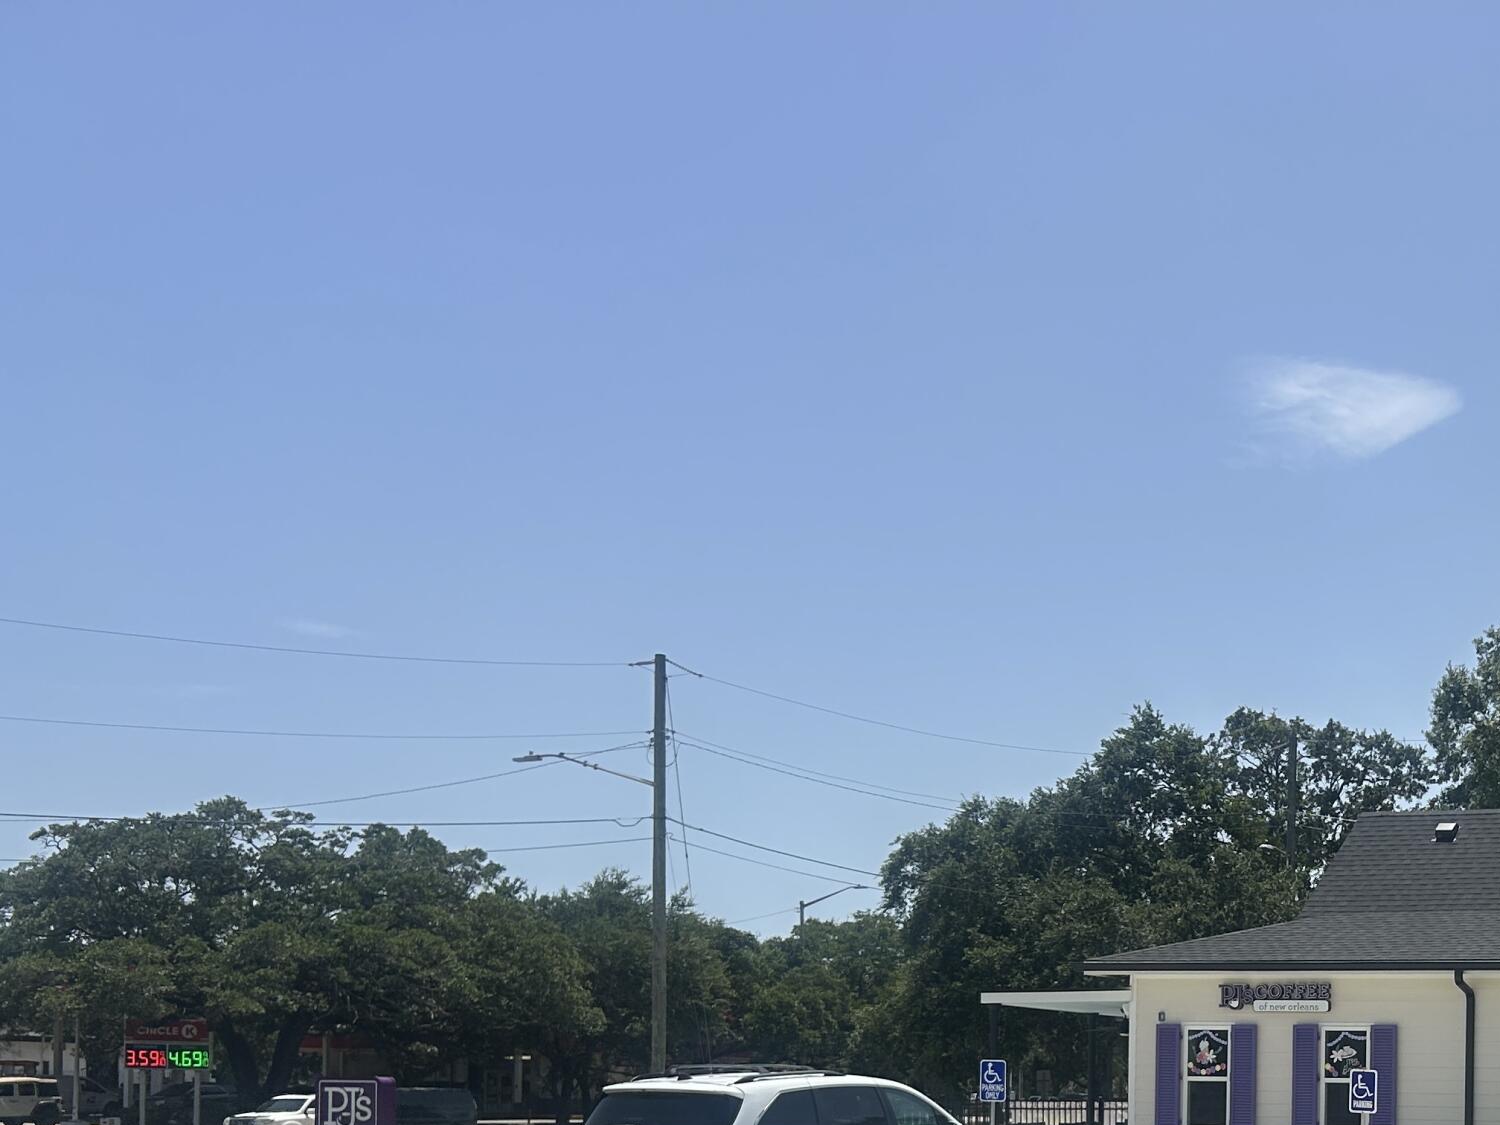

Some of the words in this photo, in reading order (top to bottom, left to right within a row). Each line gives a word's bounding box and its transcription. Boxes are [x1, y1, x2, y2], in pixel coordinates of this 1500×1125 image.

[1219, 984, 1254, 1009] PJ's
[1254, 984, 1331, 1000] COFFEE
[1259, 1002, 1266, 1011] of
[1287, 1002, 1320, 1011] orleans
[183, 1024, 197, 1038] K
[981, 1083, 1004, 1092] PARKING
[985, 1091, 1000, 1099] ONLY
[1352, 1100, 1373, 1108] PARKING
